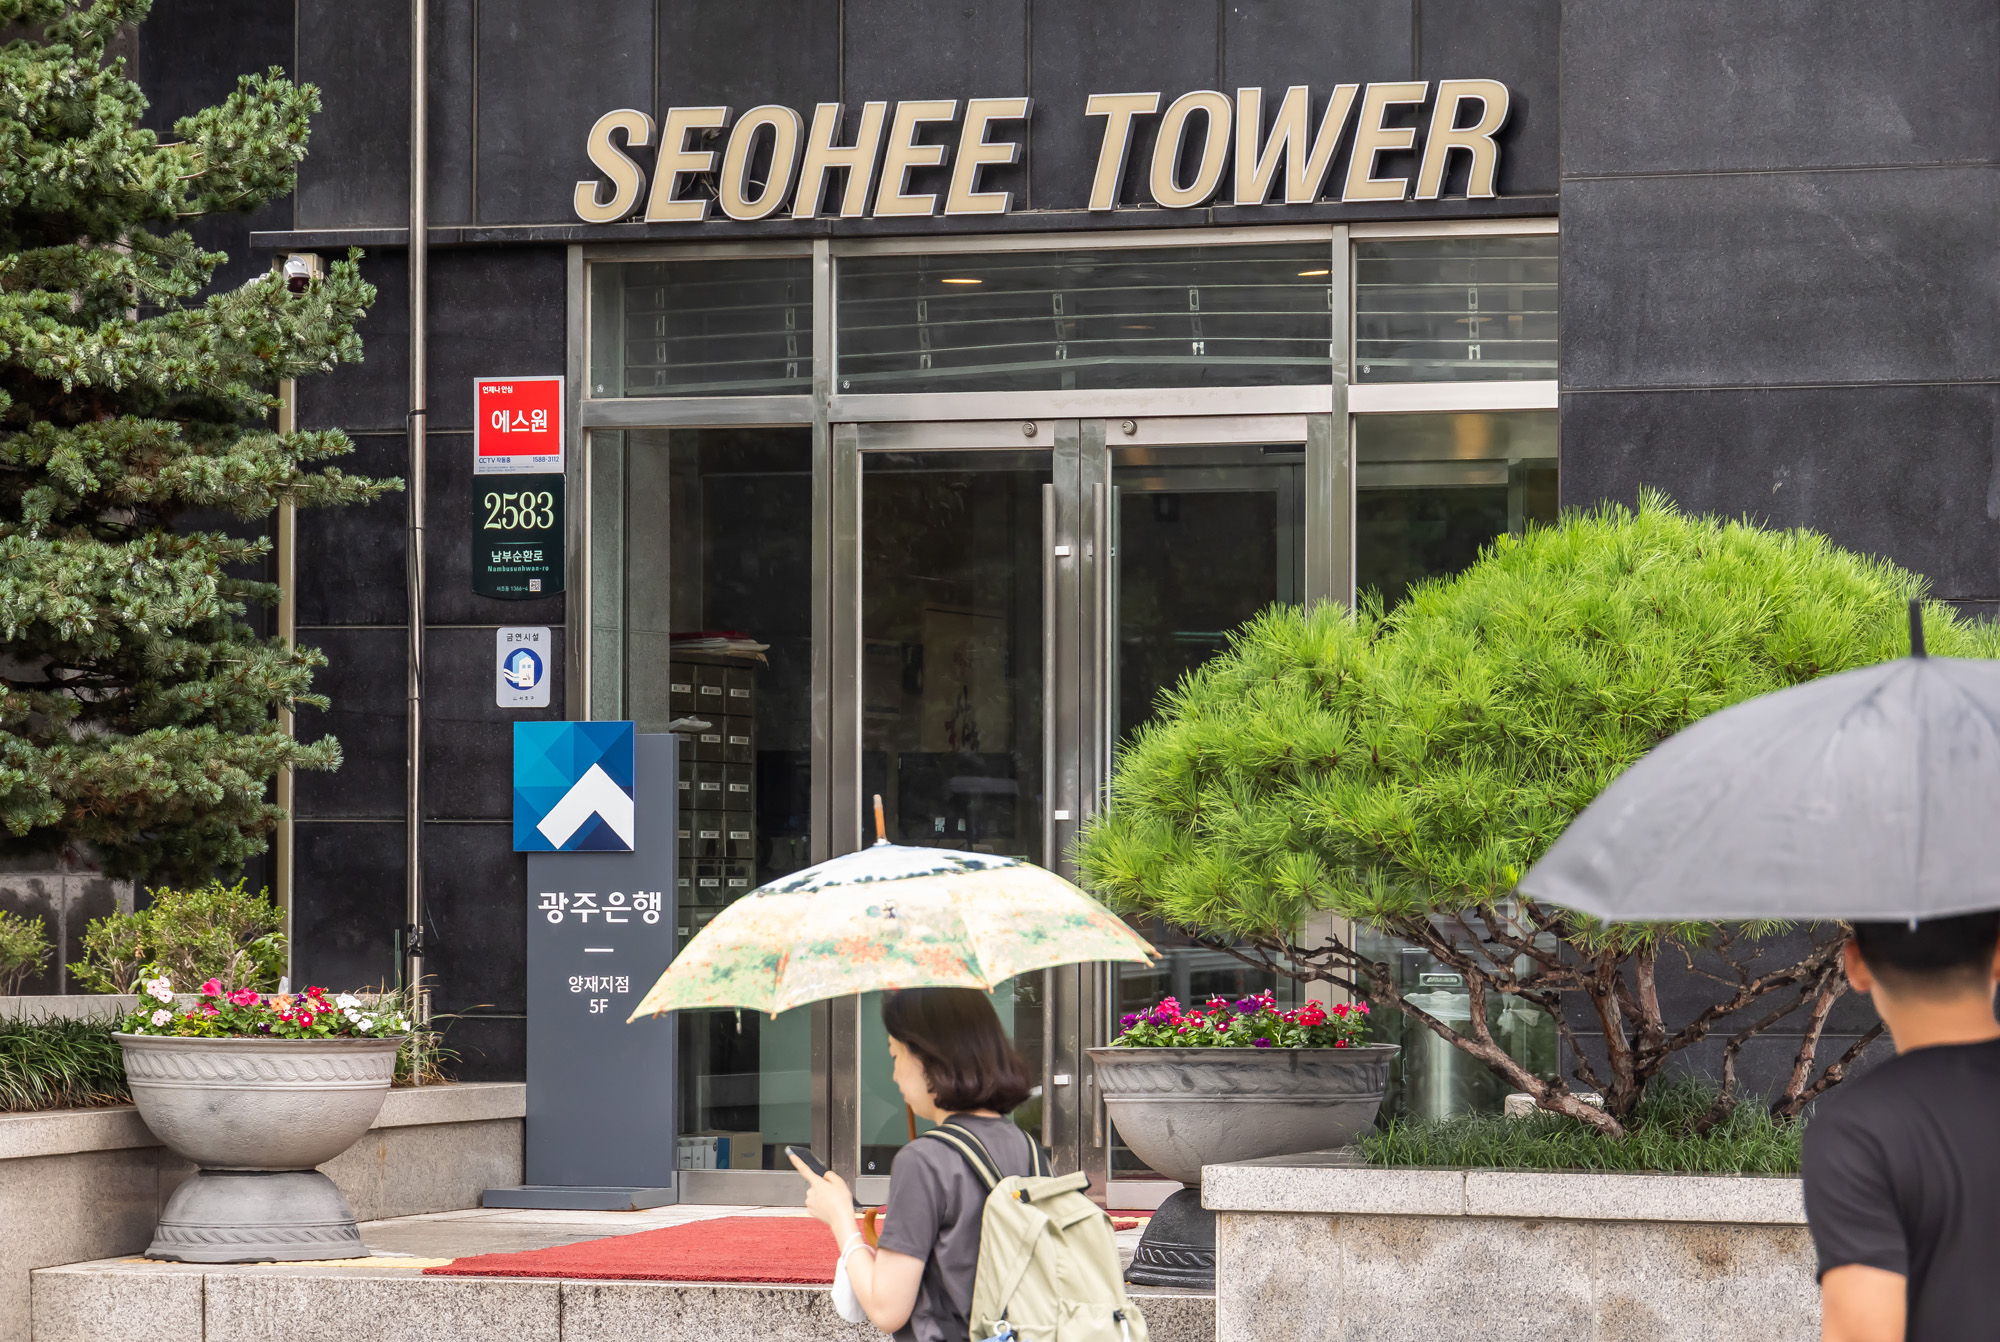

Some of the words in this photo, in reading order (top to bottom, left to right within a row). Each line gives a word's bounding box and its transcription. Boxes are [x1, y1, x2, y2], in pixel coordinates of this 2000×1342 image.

[573, 97, 1032, 223] SEOHEE
[1085, 78, 1512, 211] TOWER
[482, 385, 500, 394] 언제나
[501, 385, 513, 394] 안심
[491, 408, 547, 433] 에스원
[483, 491, 554, 530] 2583
[491, 549, 544, 563] 남부순환로
[506, 633, 539, 642] 금연시설
[537, 890, 662, 924] 광주은행
[568, 975, 630, 994] 양재지점
[589, 998, 609, 1014] 5F
